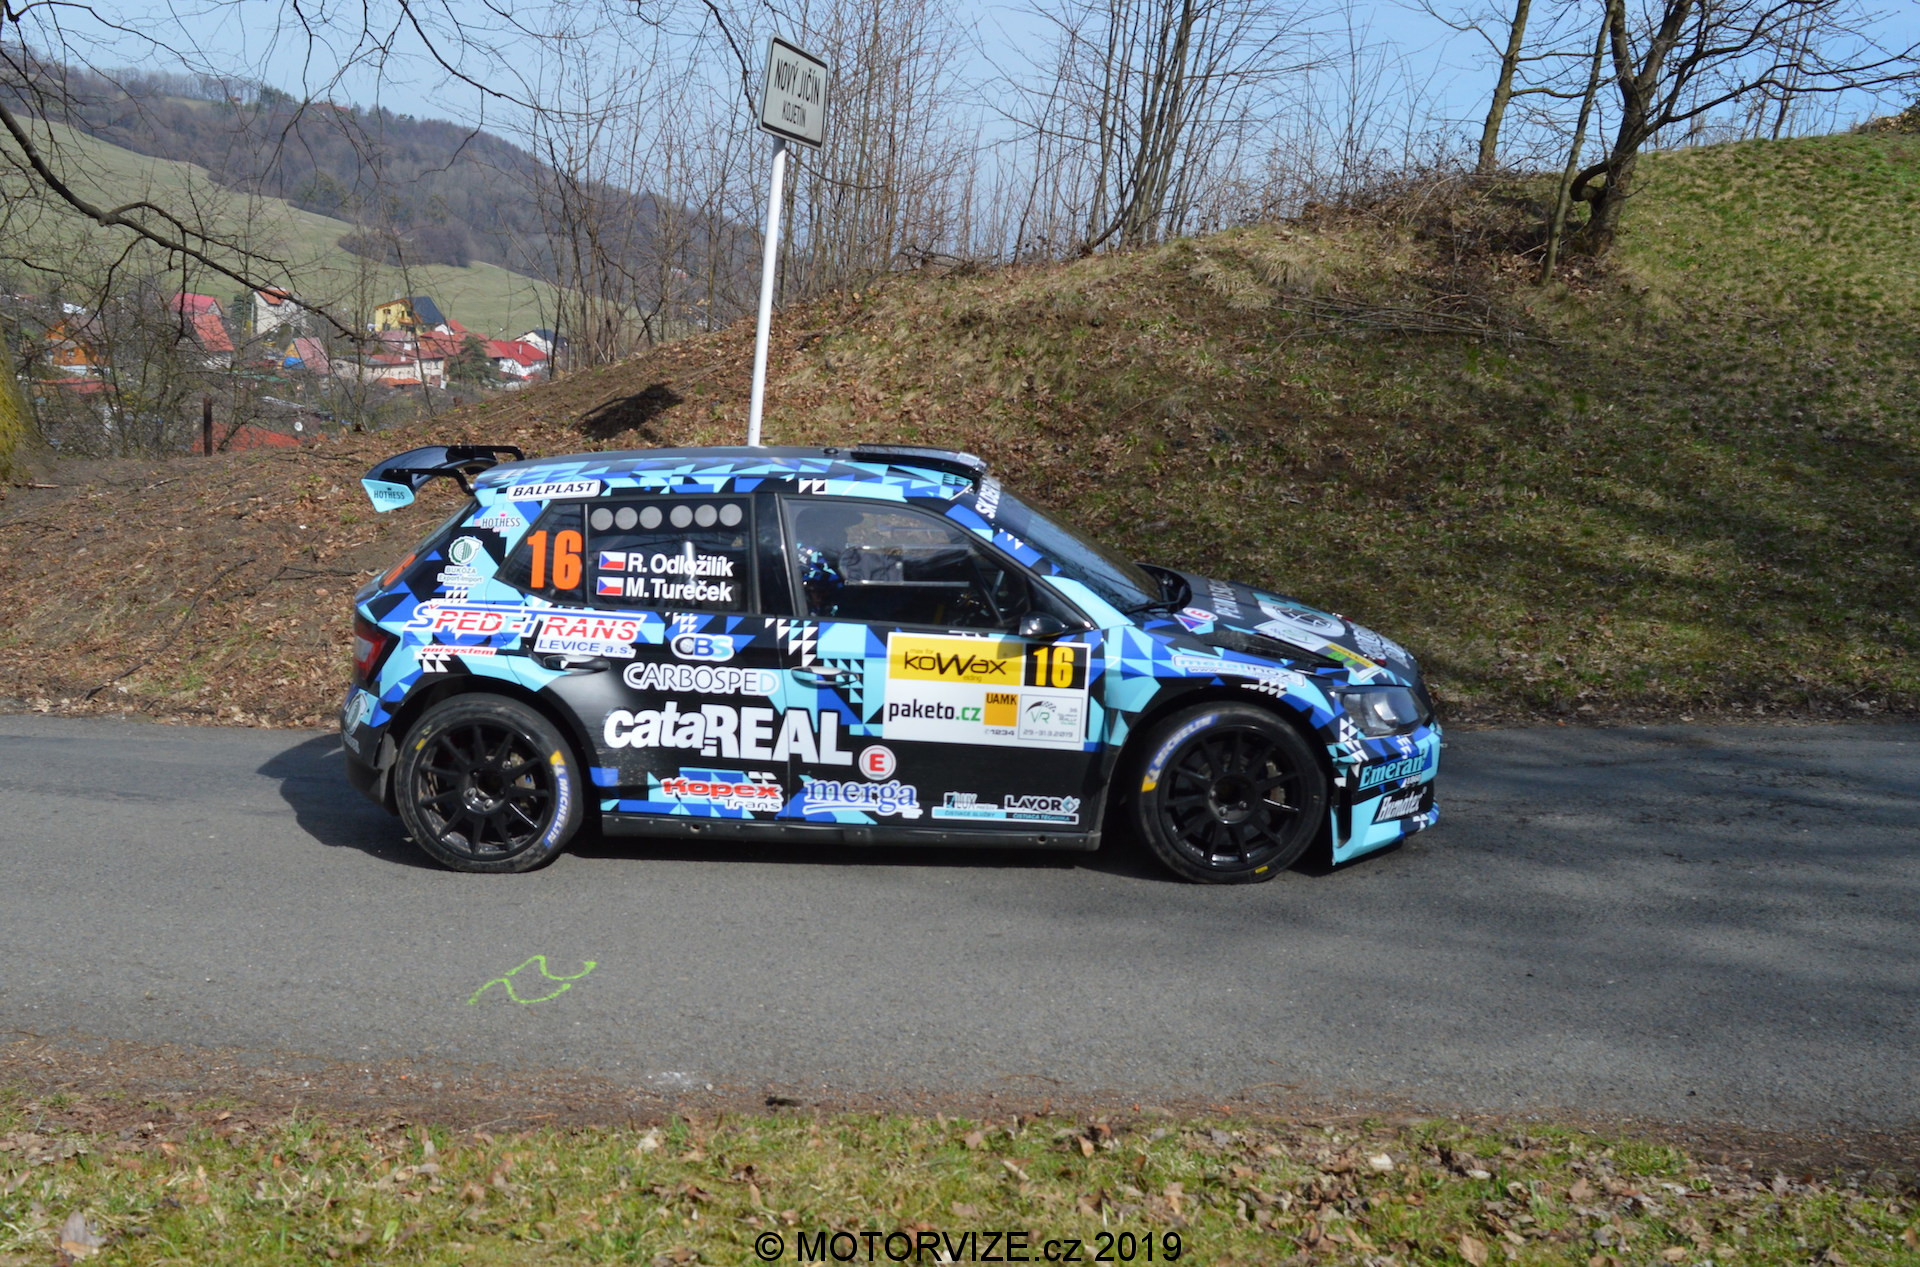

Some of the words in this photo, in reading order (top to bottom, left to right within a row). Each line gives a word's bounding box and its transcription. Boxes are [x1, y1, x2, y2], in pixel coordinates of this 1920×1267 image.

[774, 58, 799, 95] NOVÝ
[797, 67, 821, 106] JIČÍN
[782, 100, 806, 128] KOJETÍN
[374, 490, 405, 500] HOTHESS
[513, 482, 595, 497] BALPLAST
[482, 517, 520, 528] HOTHESS
[528, 529, 583, 590] 16
[628, 552, 647, 573] R.
[650, 553, 734, 577] Odložilík
[626, 577, 649, 597] M.
[650, 578, 733, 602] Tureček
[538, 639, 600, 653] LEVICE
[605, 643, 633, 655] a.s.
[675, 637, 732, 657] CBS
[904, 651, 1007, 676] koWax
[1033, 646, 1074, 688] 16
[625, 664, 777, 693] CARBOSPED
[889, 699, 982, 721] paketo.cz
[986, 693, 1017, 705] UAMK
[870, 753, 885, 771] E
[1359, 756, 1424, 790] Emeran
[663, 780, 779, 798] Kopex
[805, 782, 918, 814] merga
[547, 777, 569, 844] MICHELIN
[726, 799, 780, 810] Trans
[1006, 795, 1061, 811] LAVOR
